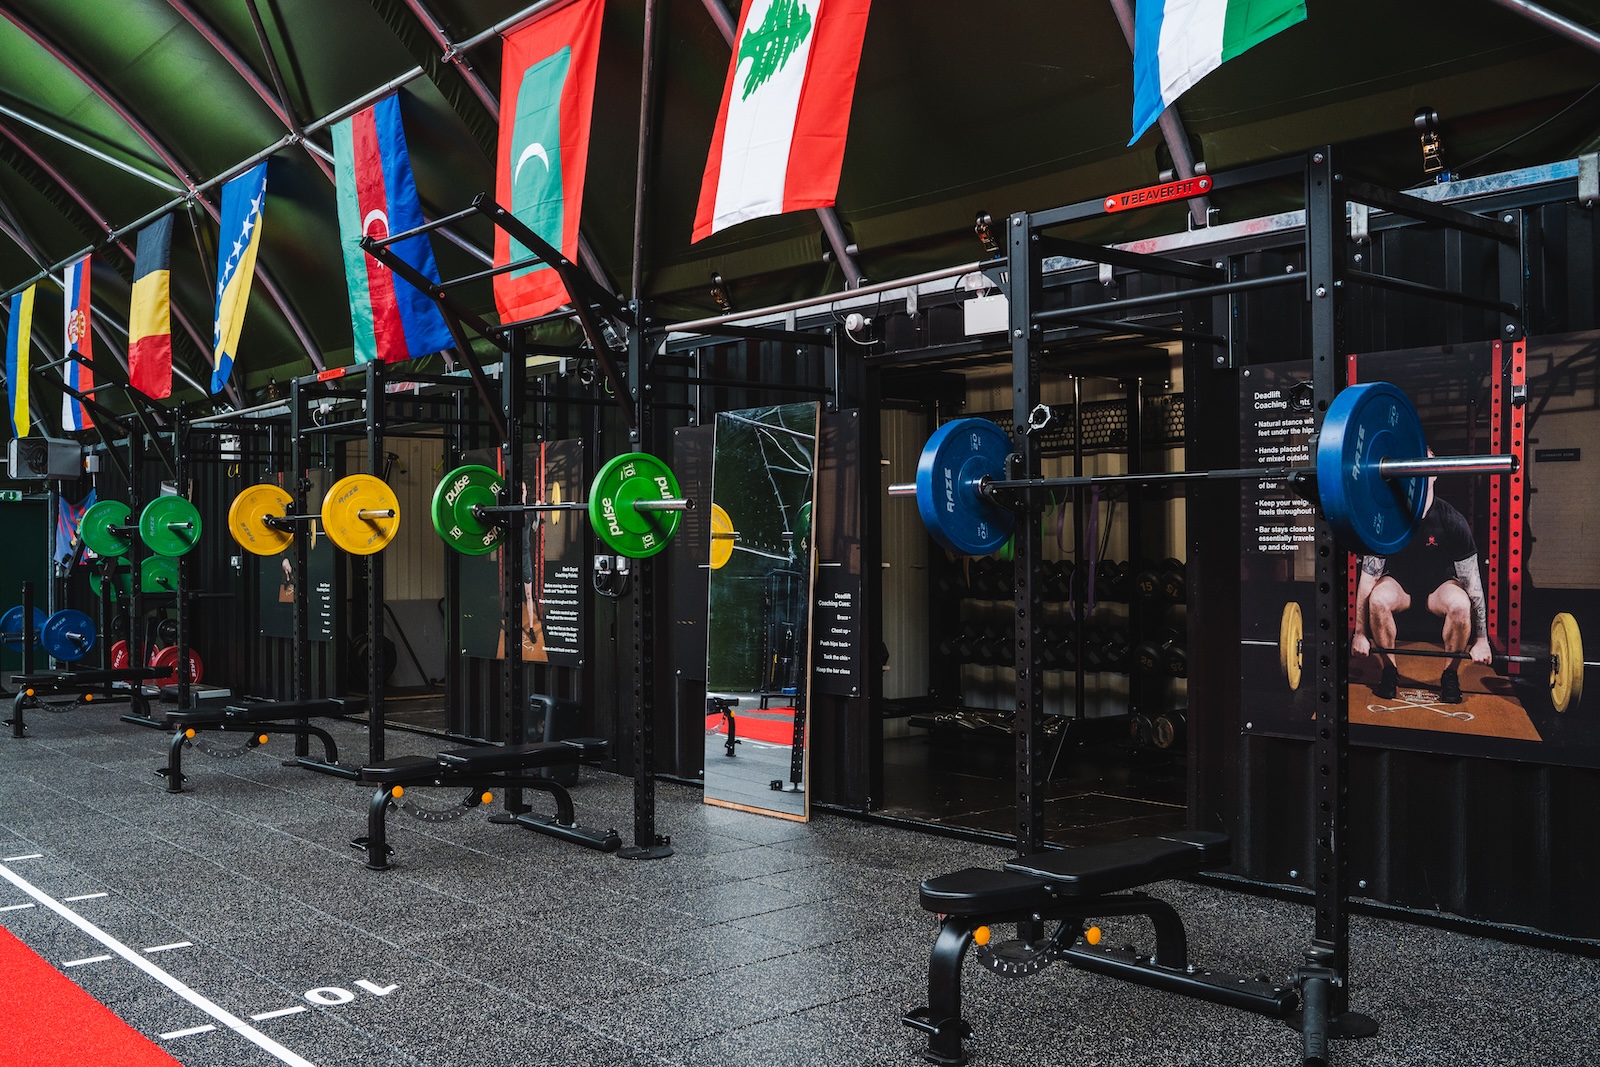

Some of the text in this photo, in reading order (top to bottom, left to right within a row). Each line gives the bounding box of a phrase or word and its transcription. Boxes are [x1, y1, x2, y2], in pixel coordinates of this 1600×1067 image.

[1254, 390, 1281, 400] Deadlift
[1254, 401, 1287, 409] Coaching
[1280, 445, 1300, 454] placed
[1352, 424, 1366, 480] RAZE
[624, 463, 635, 478] 10
[338, 485, 358, 503] RAZE
[445, 475, 470, 506] pulse
[944, 468, 955, 512] RAZE
[602, 498, 624, 536] pulse
[1276, 508, 1312, 516] throughout
[1140, 581, 1153, 592] 15
[51, 617, 66, 630] RAZE
[114, 650, 123, 668] RAZE
[304, 979, 399, 1005] 10
